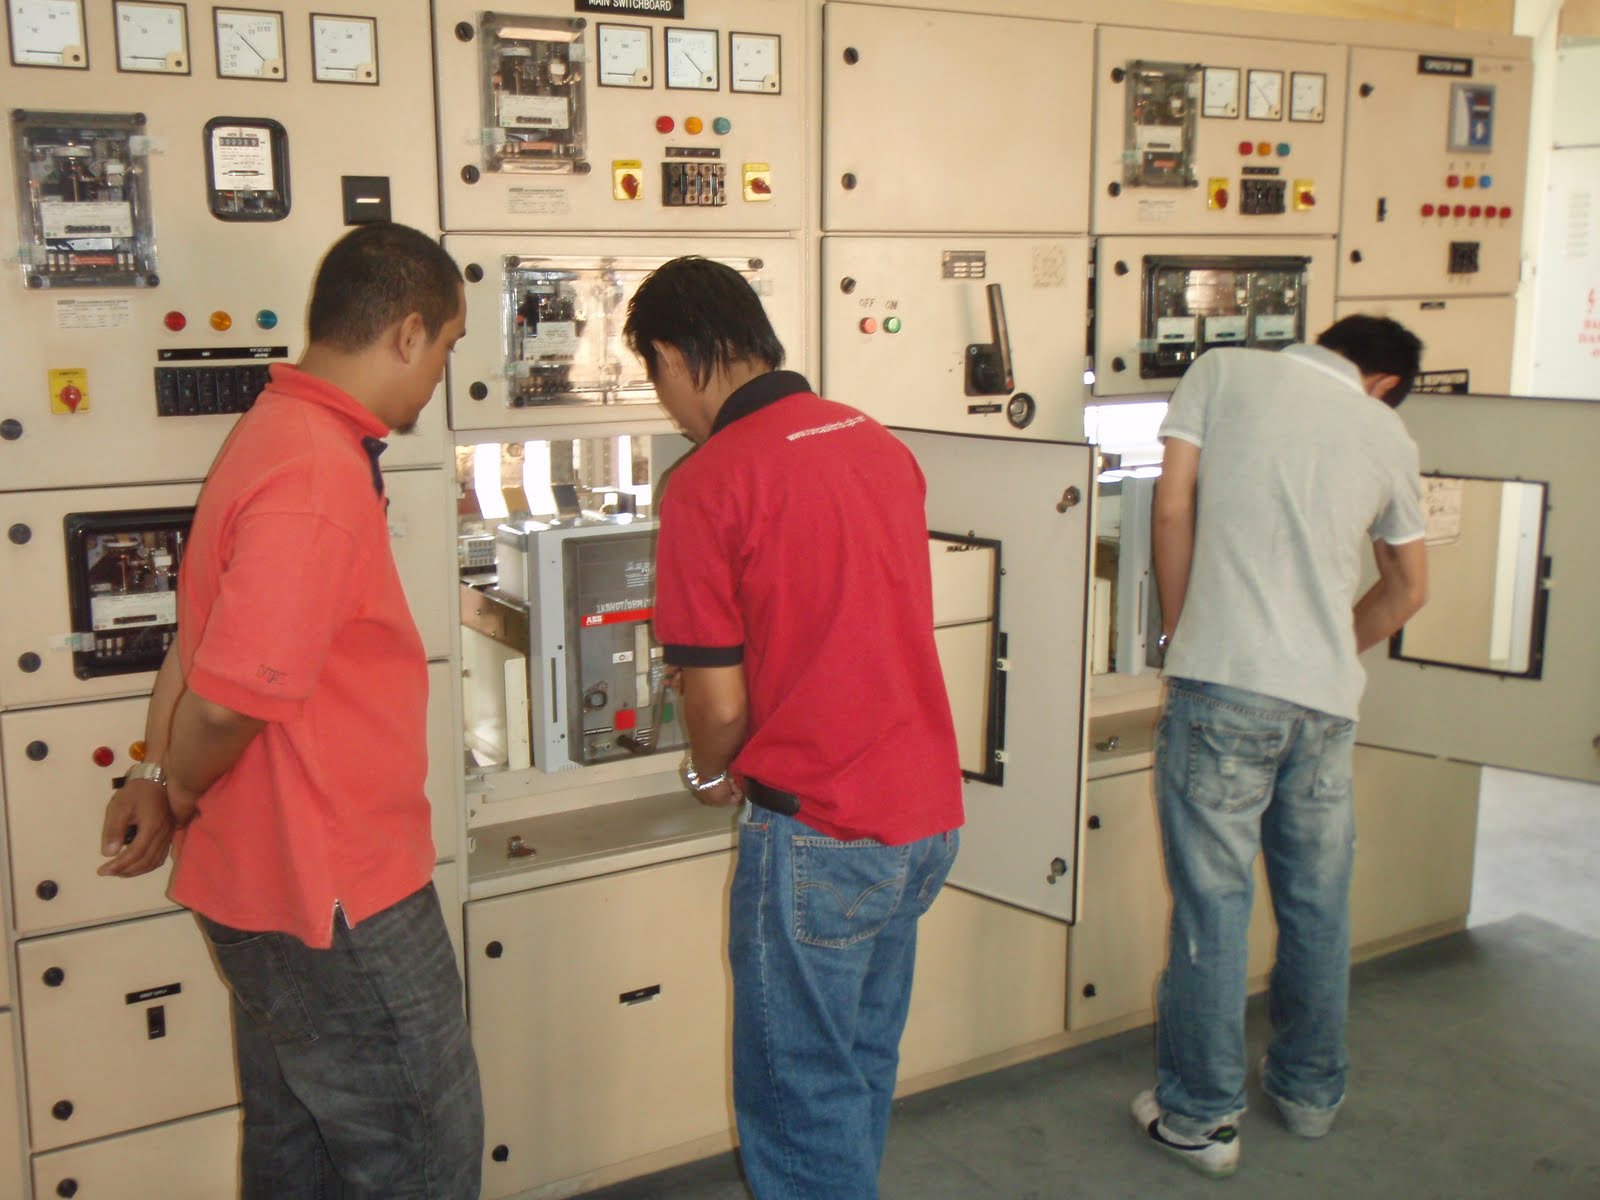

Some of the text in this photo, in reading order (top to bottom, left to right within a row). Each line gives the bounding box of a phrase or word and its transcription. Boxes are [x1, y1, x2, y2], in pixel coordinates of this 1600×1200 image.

[612, 0, 672, 11] SWITCHBOARD
[859, 298, 898, 311] OFF ON
[585, 615, 603, 626] ABB
